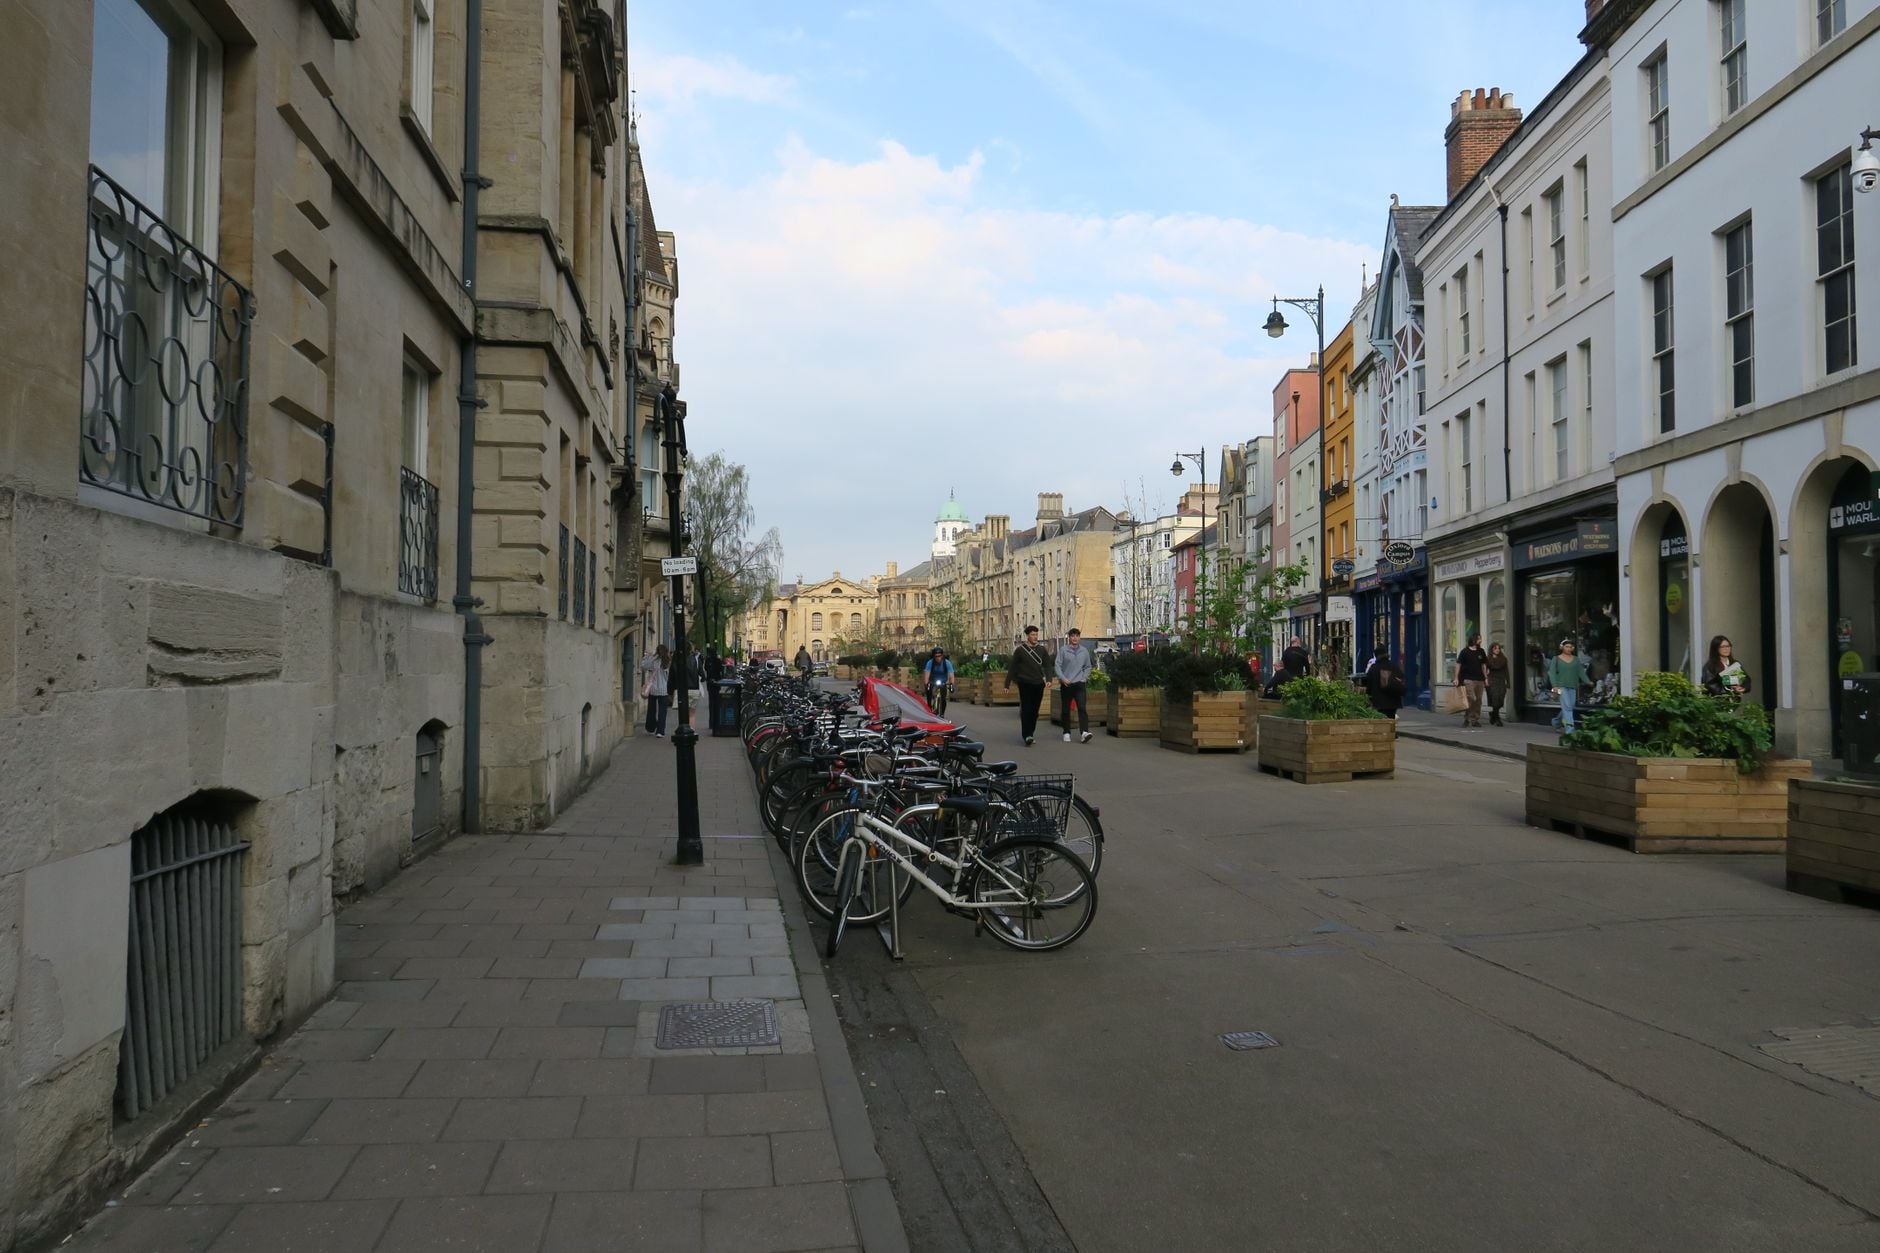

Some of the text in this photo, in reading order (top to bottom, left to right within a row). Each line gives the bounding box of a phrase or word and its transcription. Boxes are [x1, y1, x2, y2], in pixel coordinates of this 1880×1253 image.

[1388, 542, 1411, 552] Oxford
[1534, 541, 1562, 558] WATSONS
[1390, 556, 1410, 564] Stores
